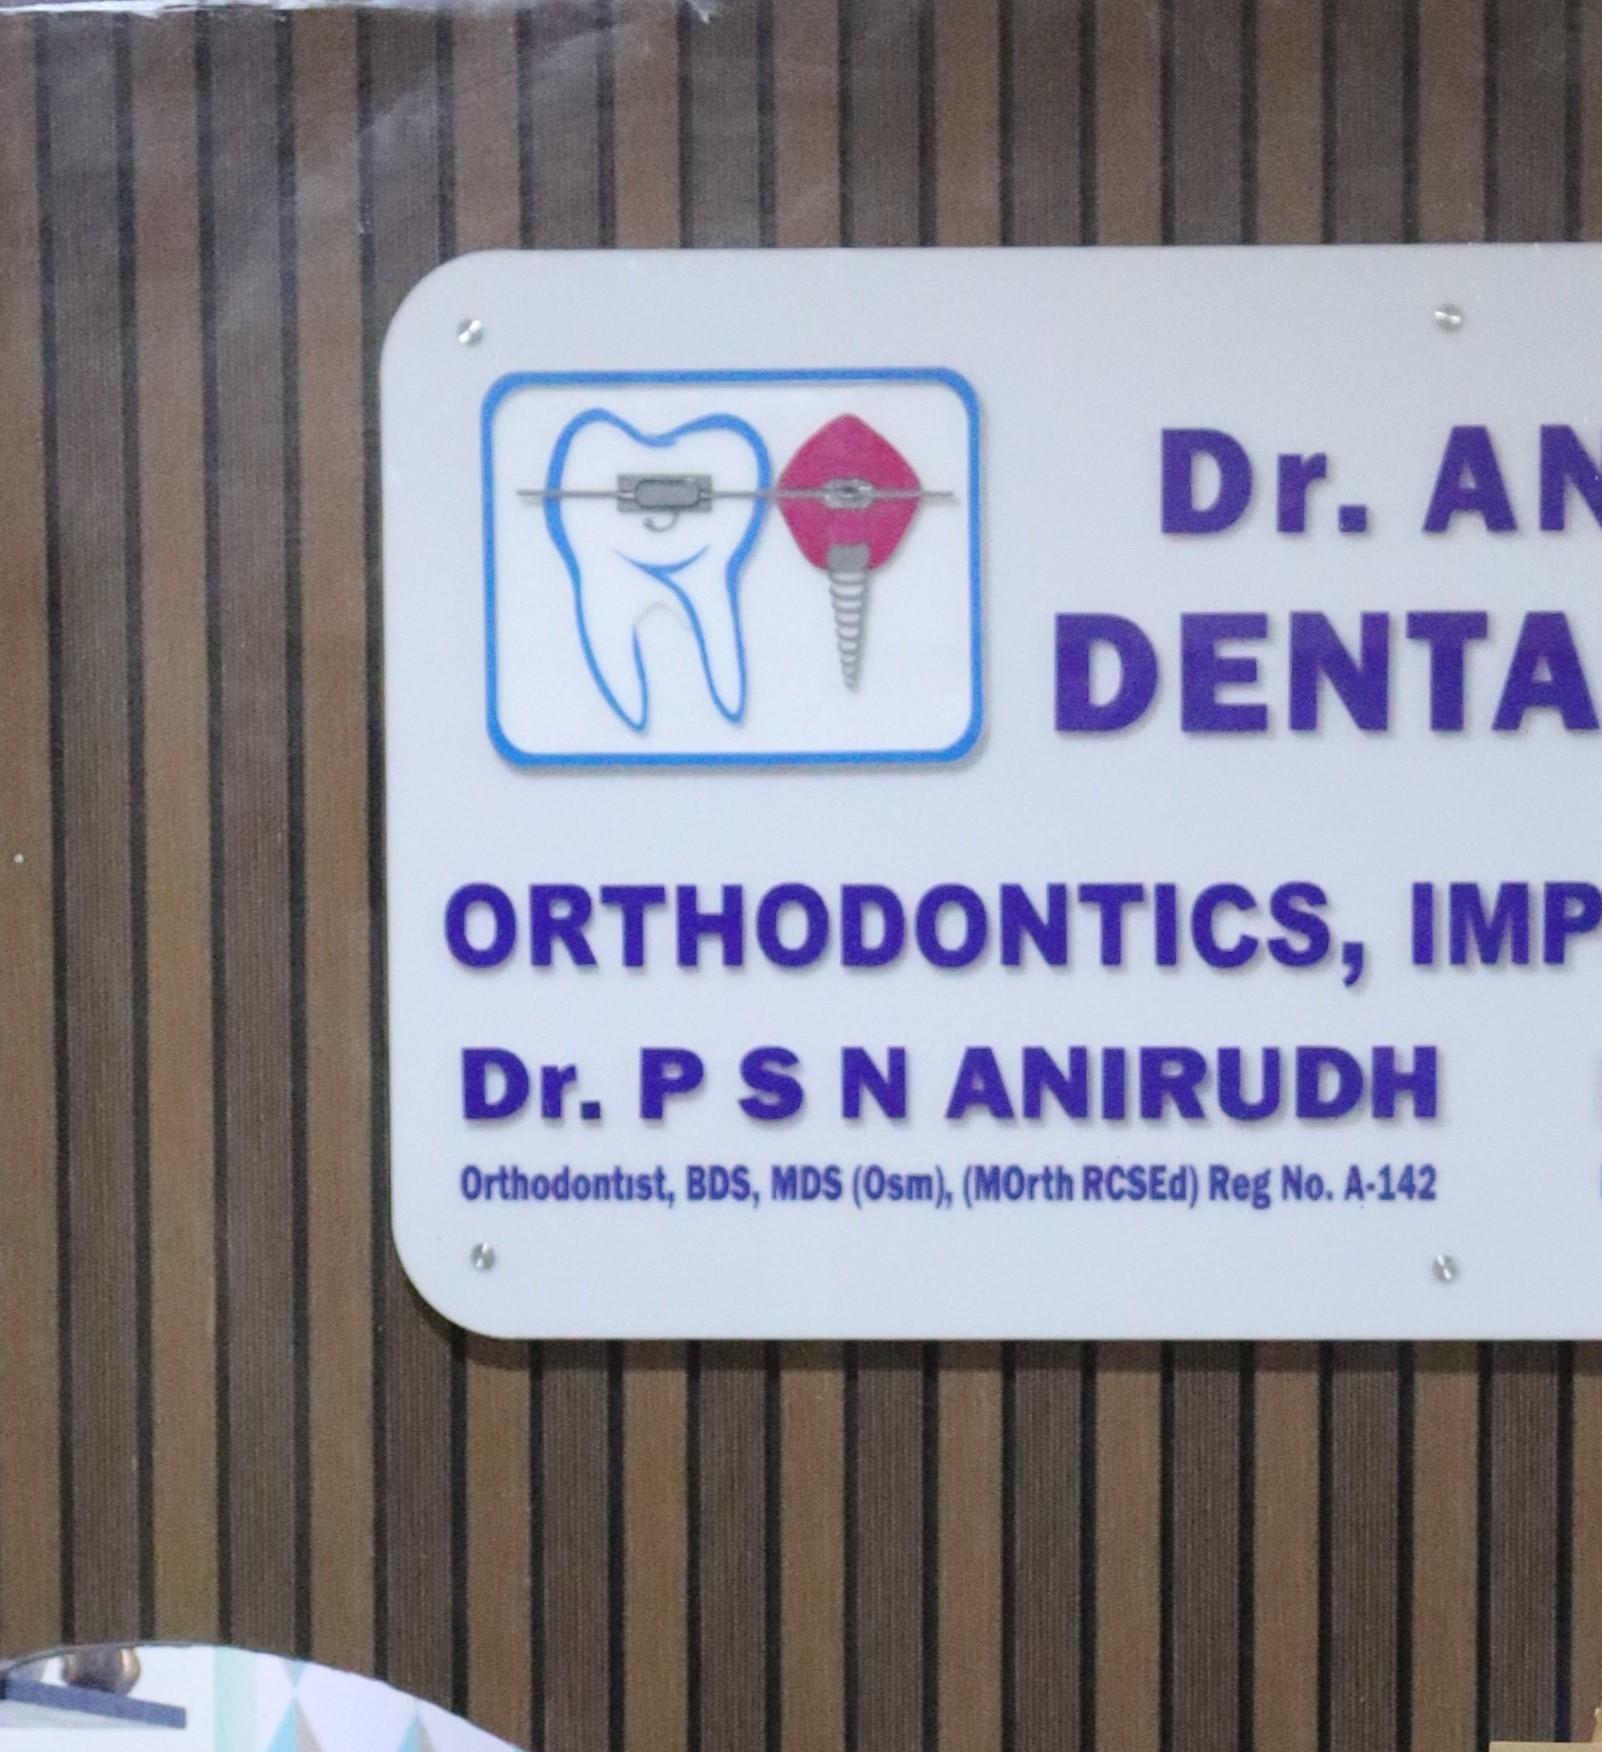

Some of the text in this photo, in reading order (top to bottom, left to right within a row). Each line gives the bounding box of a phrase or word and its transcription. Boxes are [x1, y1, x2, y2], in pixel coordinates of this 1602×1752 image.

[1161, 428, 1369, 536] Dr.
[444, 881, 1365, 987] ORTHODONTICS,
[462, 1045, 1438, 1123] Dr. P S N ANIRUDH
[460, 1164, 1437, 1210] Orthodontist, BDS, MDS (Osm), (MOrth RCSEd) Reg No. A-142
